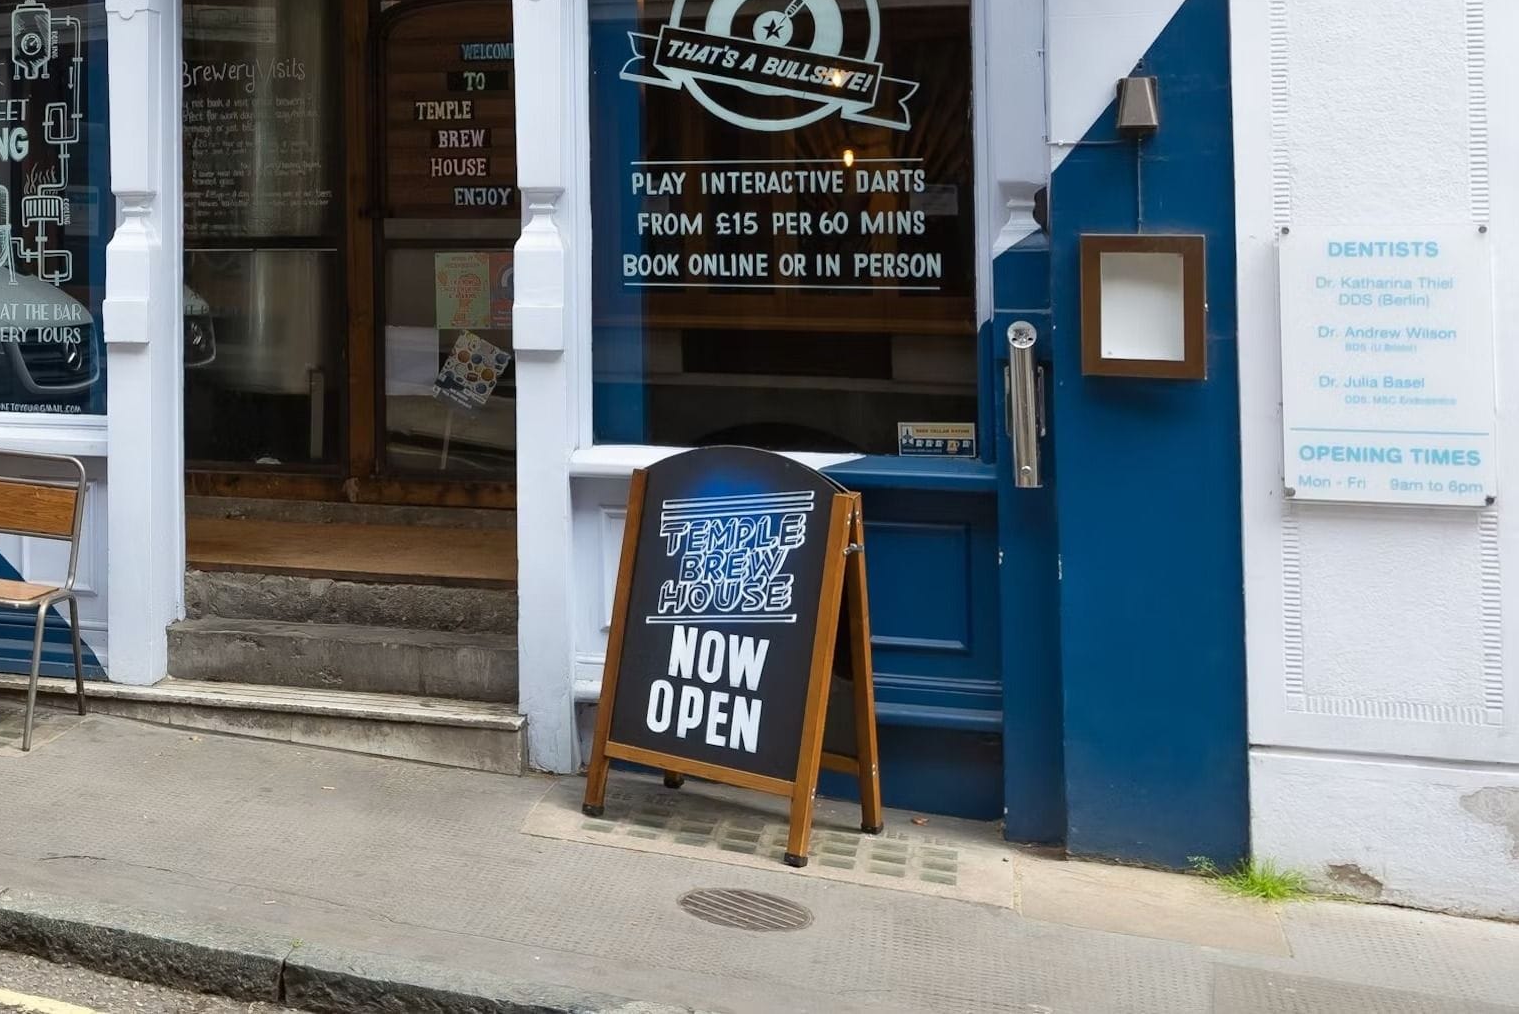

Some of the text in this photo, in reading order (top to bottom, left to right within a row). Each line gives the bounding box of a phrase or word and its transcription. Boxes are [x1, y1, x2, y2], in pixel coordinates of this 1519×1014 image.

[181, 58, 306, 93] Brewery Visits
[666, 39, 874, 93] THAT'S A BULLSEYE!
[464, 71, 486, 91] TO
[416, 101, 472, 120] TEMPLE
[438, 130, 485, 147] BREW
[431, 157, 487, 177] HOUSE
[631, 169, 926, 195] PLAY INTERACTIVE DARTS
[454, 188, 511, 206] ENJOY
[638, 211, 926, 236] FROM £15 PER 60 MINS
[1328, 241, 1439, 258] DENTISTS
[622, 253, 942, 278] BOOK ONLINE OR IN PERSON
[1316, 276, 1454, 290] Dr. Katharina Thiel
[1338, 293, 1430, 308] DDS (Berlin)
[0, 303, 19, 321] AT
[23, 303, 49, 321] THE
[53, 303, 81, 321] BAR
[35, 326, 81, 344] TOURS
[1318, 326, 1457, 339] Dr. Andrew Wilson
[1318, 375, 1425, 388] Dr. Julia Basel
[1299, 445, 1481, 466] OPENING TIMES
[1298, 474, 1331, 488] Mon
[1347, 476, 1366, 489] Fri
[1389, 478, 1423, 492] 9am
[1426, 480, 1443, 493] to
[660, 513, 806, 556] TEMPLE
[679, 547, 788, 585] BREW
[657, 574, 794, 614] HOUSE
[668, 624, 770, 692] NOW
[646, 679, 763, 754] OPEN
